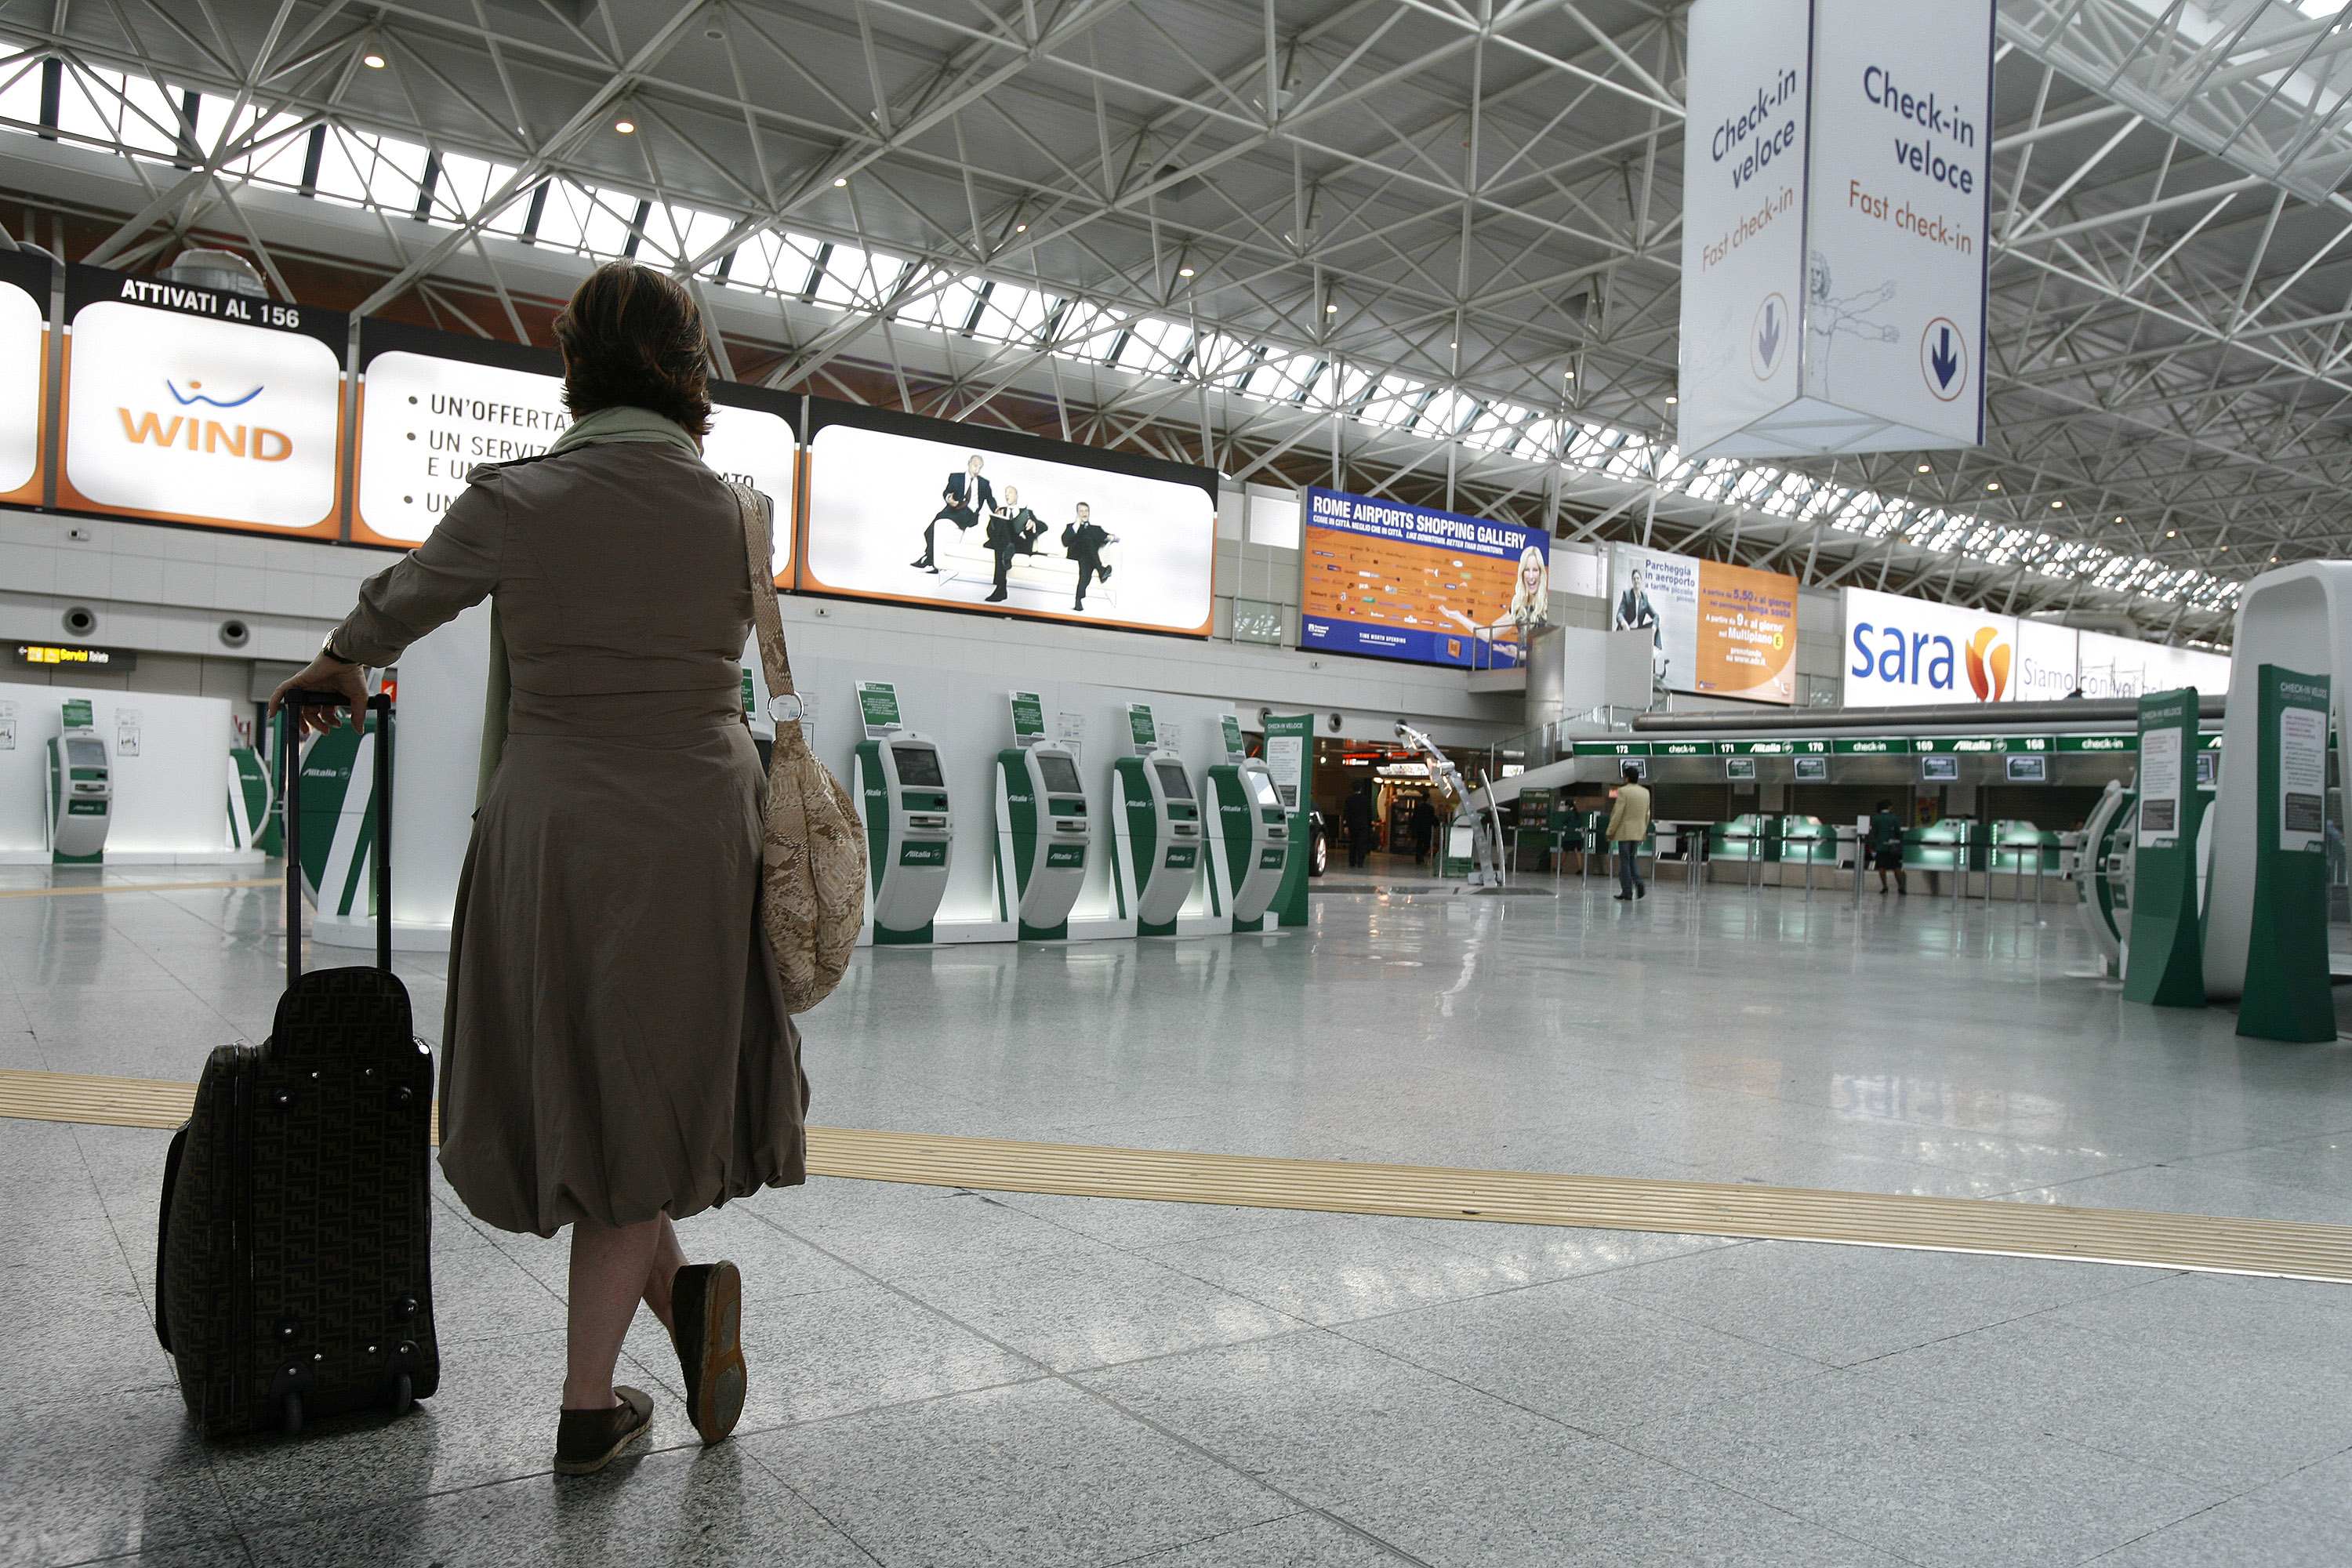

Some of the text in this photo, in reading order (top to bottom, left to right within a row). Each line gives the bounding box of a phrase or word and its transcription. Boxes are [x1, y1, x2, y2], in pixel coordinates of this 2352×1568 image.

[1864, 66, 1973, 147] Check-in
[1712, 69, 1796, 162] Check-in
[1733, 120, 1795, 189] veloce
[1895, 139, 1973, 194] veloce
[1849, 180, 1971, 256] Fast check-in
[1702, 187, 1793, 273] Fast check-in
[121, 279, 300, 328] ATTIVATI AL 156
[431, 394, 566, 432] UN'OFFERTA
[118, 406, 294, 462] WIND
[430, 430, 460, 452] UN
[428, 457, 440, 477] E
[1312, 515, 1328, 524] COME
[1313, 495, 1526, 550] ROME AIRPORTS SHOPPING GALLERY
[1646, 559, 1691, 576] Parcheggia
[1656, 573, 1695, 586] aeroporto
[1737, 613, 1744, 626] 9
[1727, 626, 1772, 644] Multipiano
[60, 648, 88, 662] Servizi
[1852, 622, 1954, 689] sara
[2024, 658, 2074, 691] Siamo
[1616, 745, 1628, 754] 172
[1668, 745, 1697, 754] check-in
[1721, 742, 1781, 753] 171 Alitalia
[1808, 742, 1824, 753] 170
[1853, 742, 1887, 752] check-in
[1915, 740, 1991, 752] 169 Alitalia
[2082, 738, 2124, 750] check-in
[303, 768, 337, 778] Alitalia
[865, 789, 881, 798] Alitalia
[905, 850, 931, 858] Alitalia
[1051, 852, 1073, 861] Alitalia
